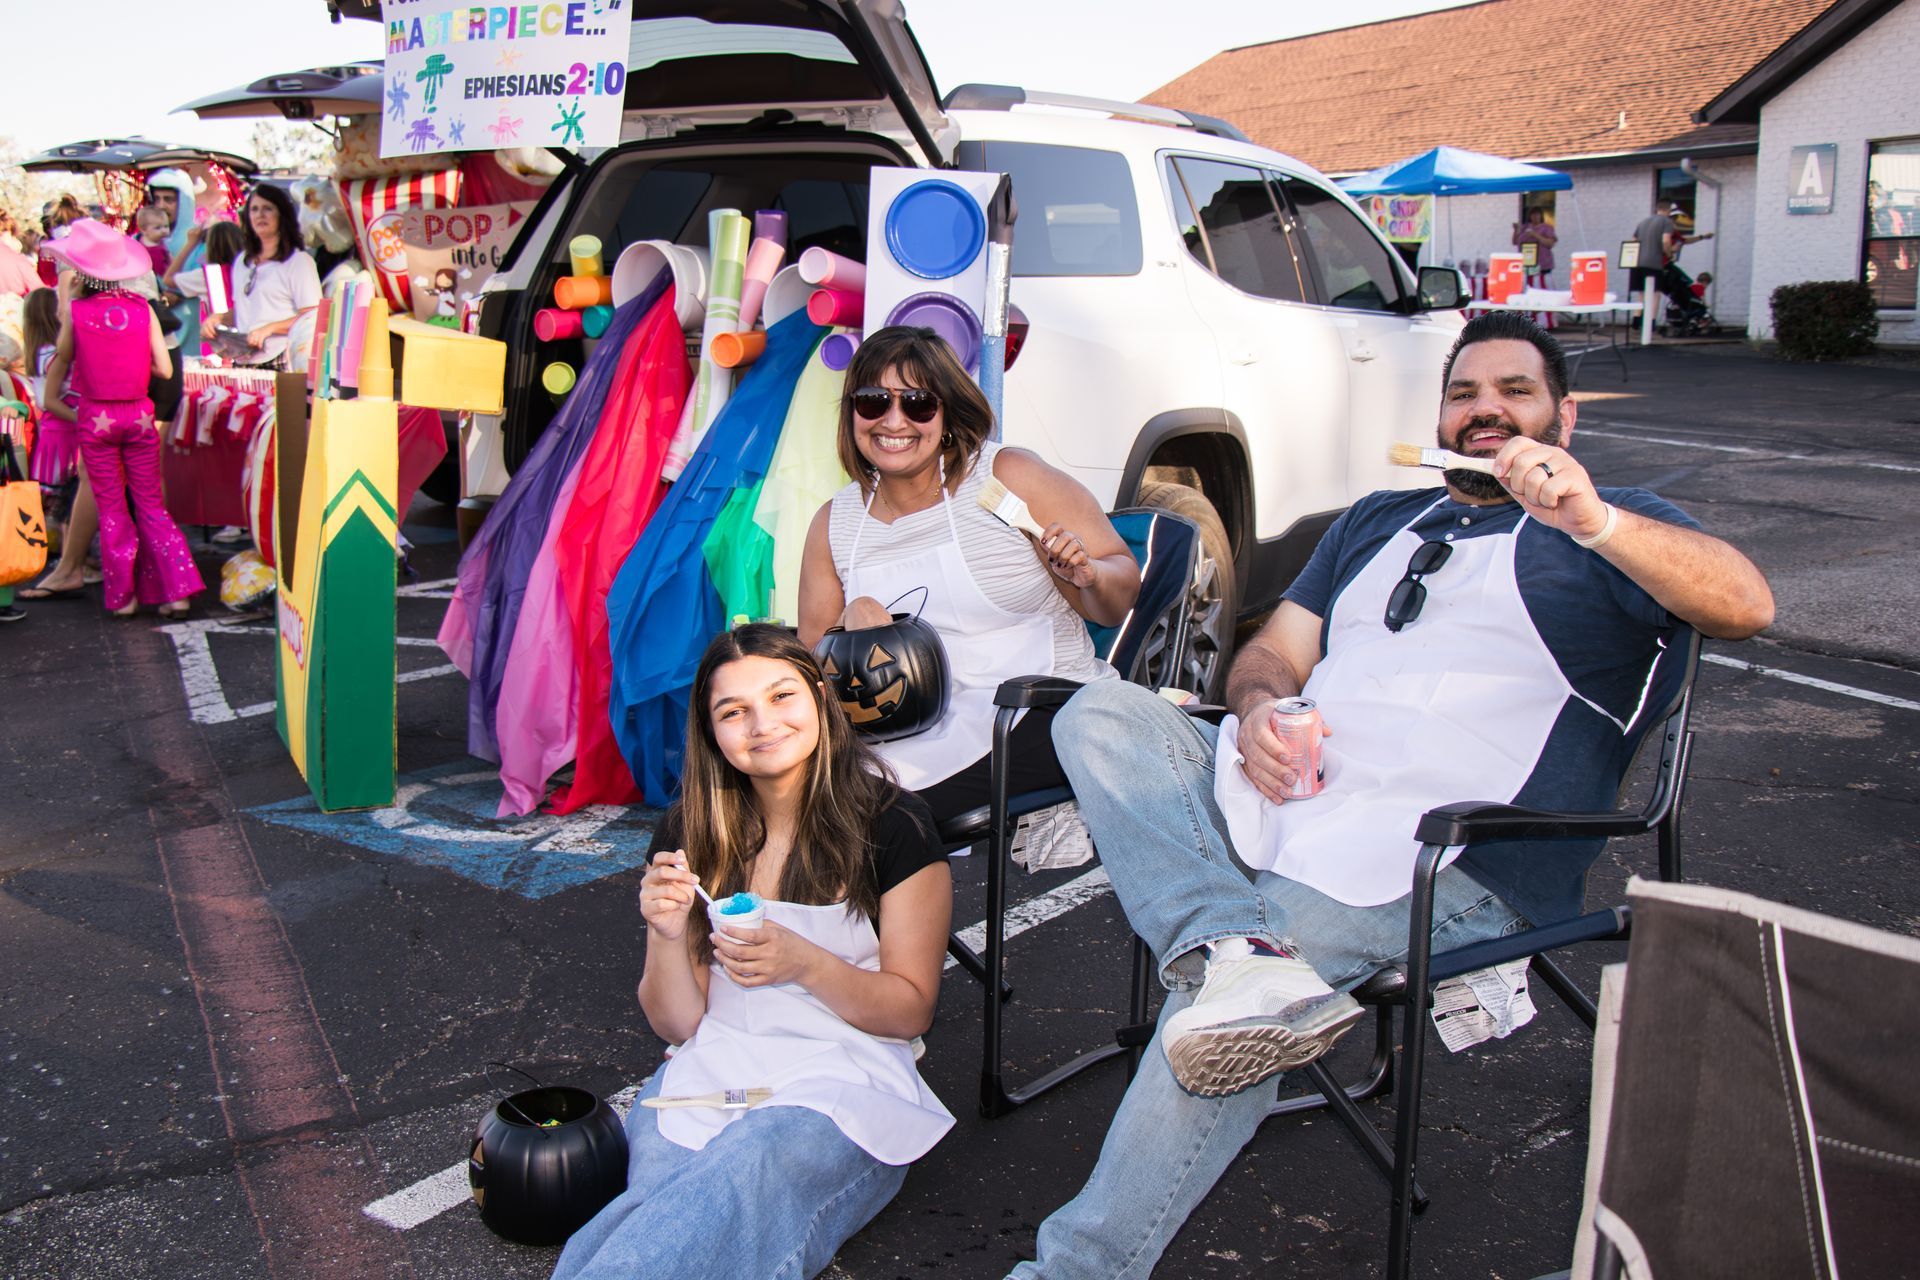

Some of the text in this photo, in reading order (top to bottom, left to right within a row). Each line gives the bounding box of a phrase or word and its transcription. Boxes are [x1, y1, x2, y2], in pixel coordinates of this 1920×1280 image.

[464, 61, 625, 99] EPHESIANS 2:10
[1797, 152, 1824, 195] A
[1789, 196, 1831, 208] BUILDING
[424, 214, 493, 245] POP
[375, 237, 404, 262] COR
[451, 246, 487, 268] into
